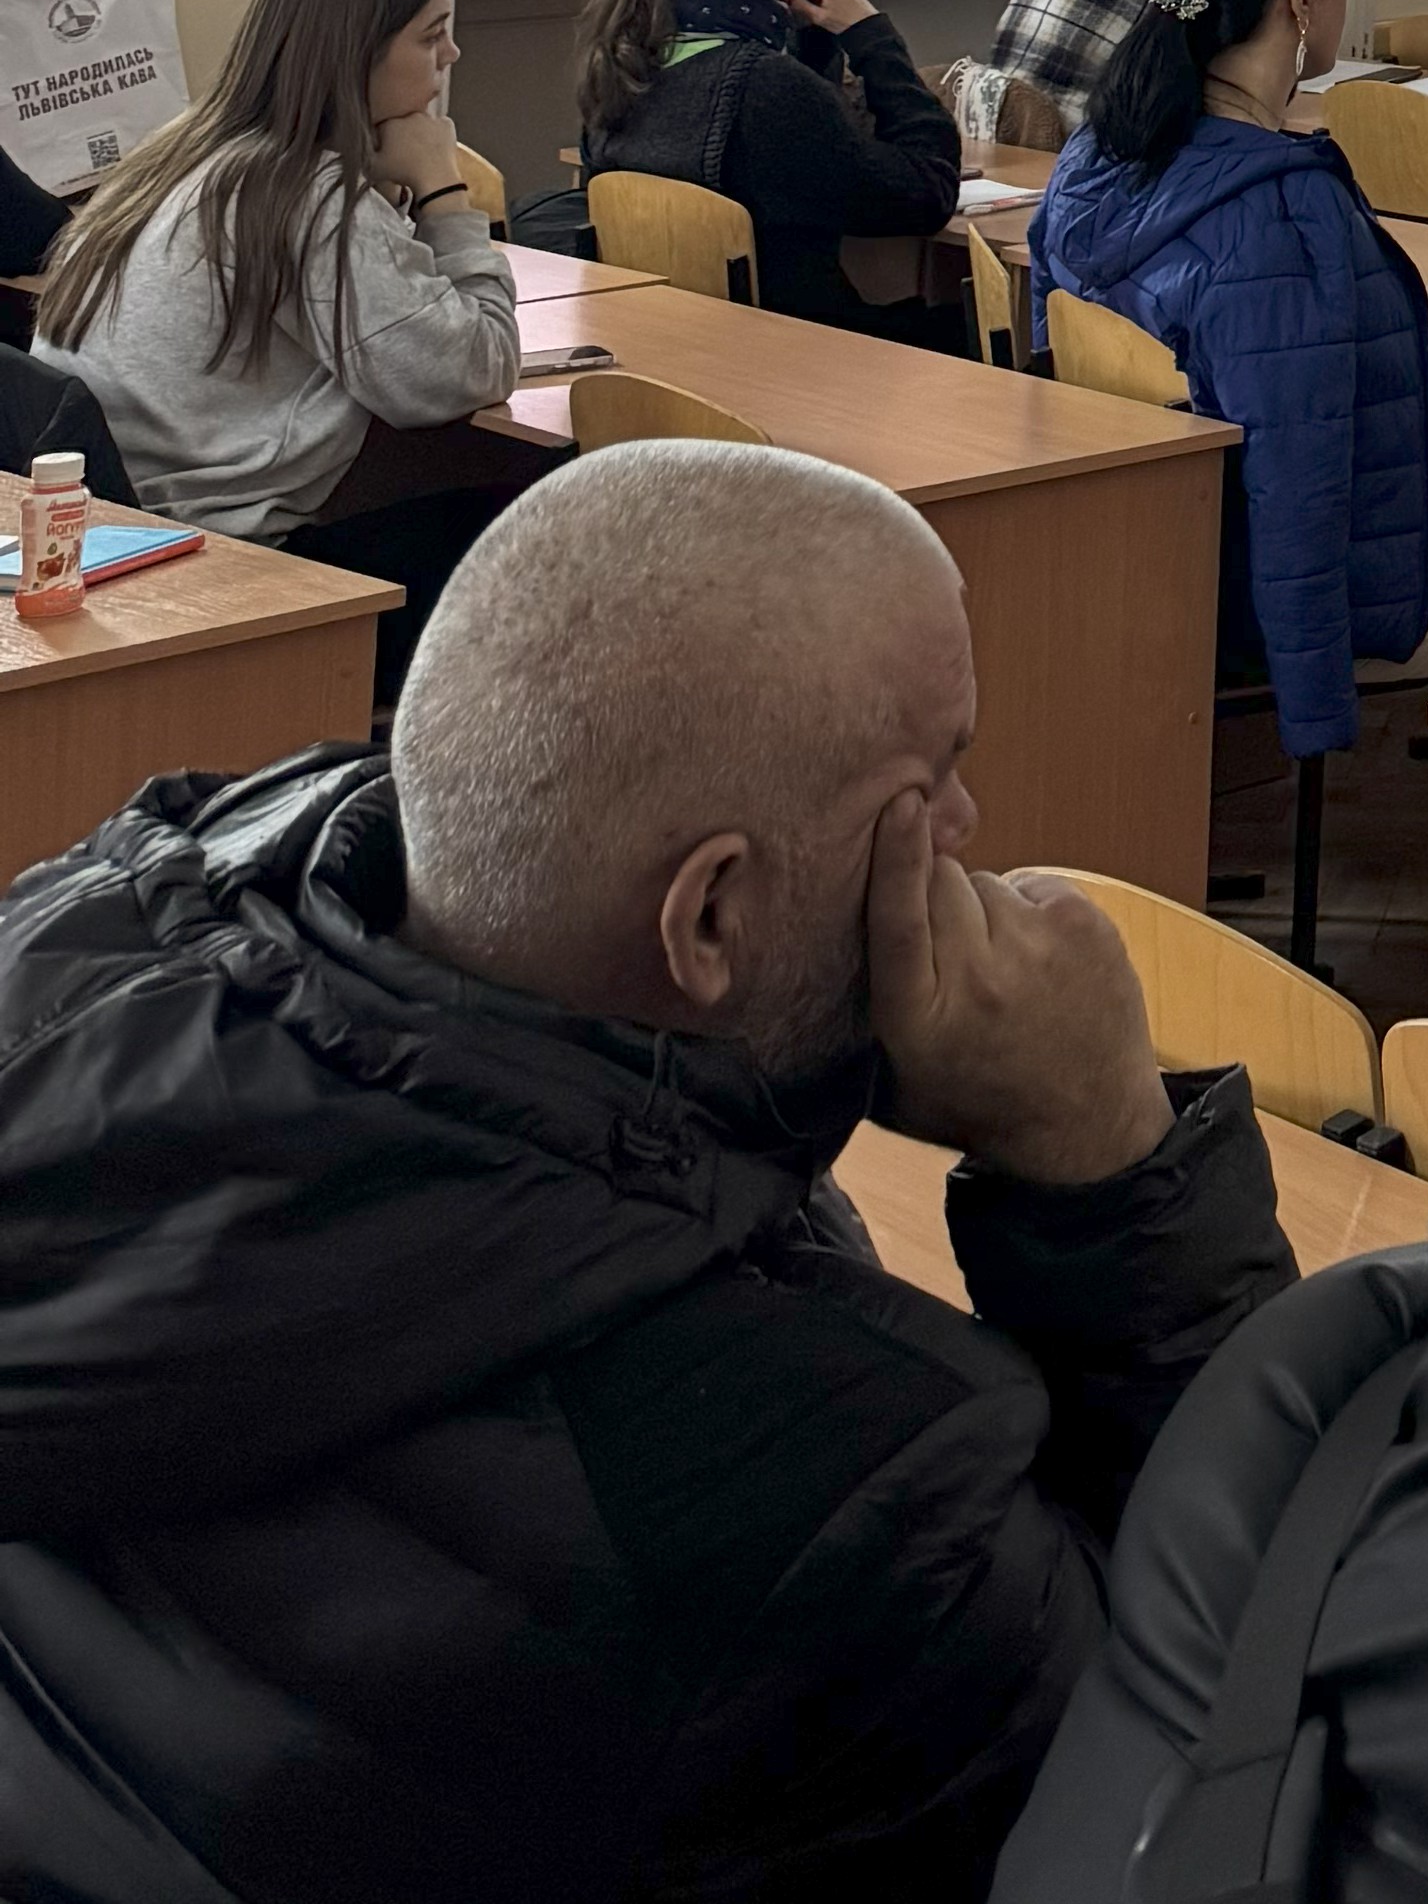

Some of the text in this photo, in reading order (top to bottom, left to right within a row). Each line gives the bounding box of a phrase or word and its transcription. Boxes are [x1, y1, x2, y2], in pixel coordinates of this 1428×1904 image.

[12, 47, 153, 101] ТУТ НАРОДИЛАСЬ
[19, 65, 157, 120] ЛЬВІВСЬКА КАВА
